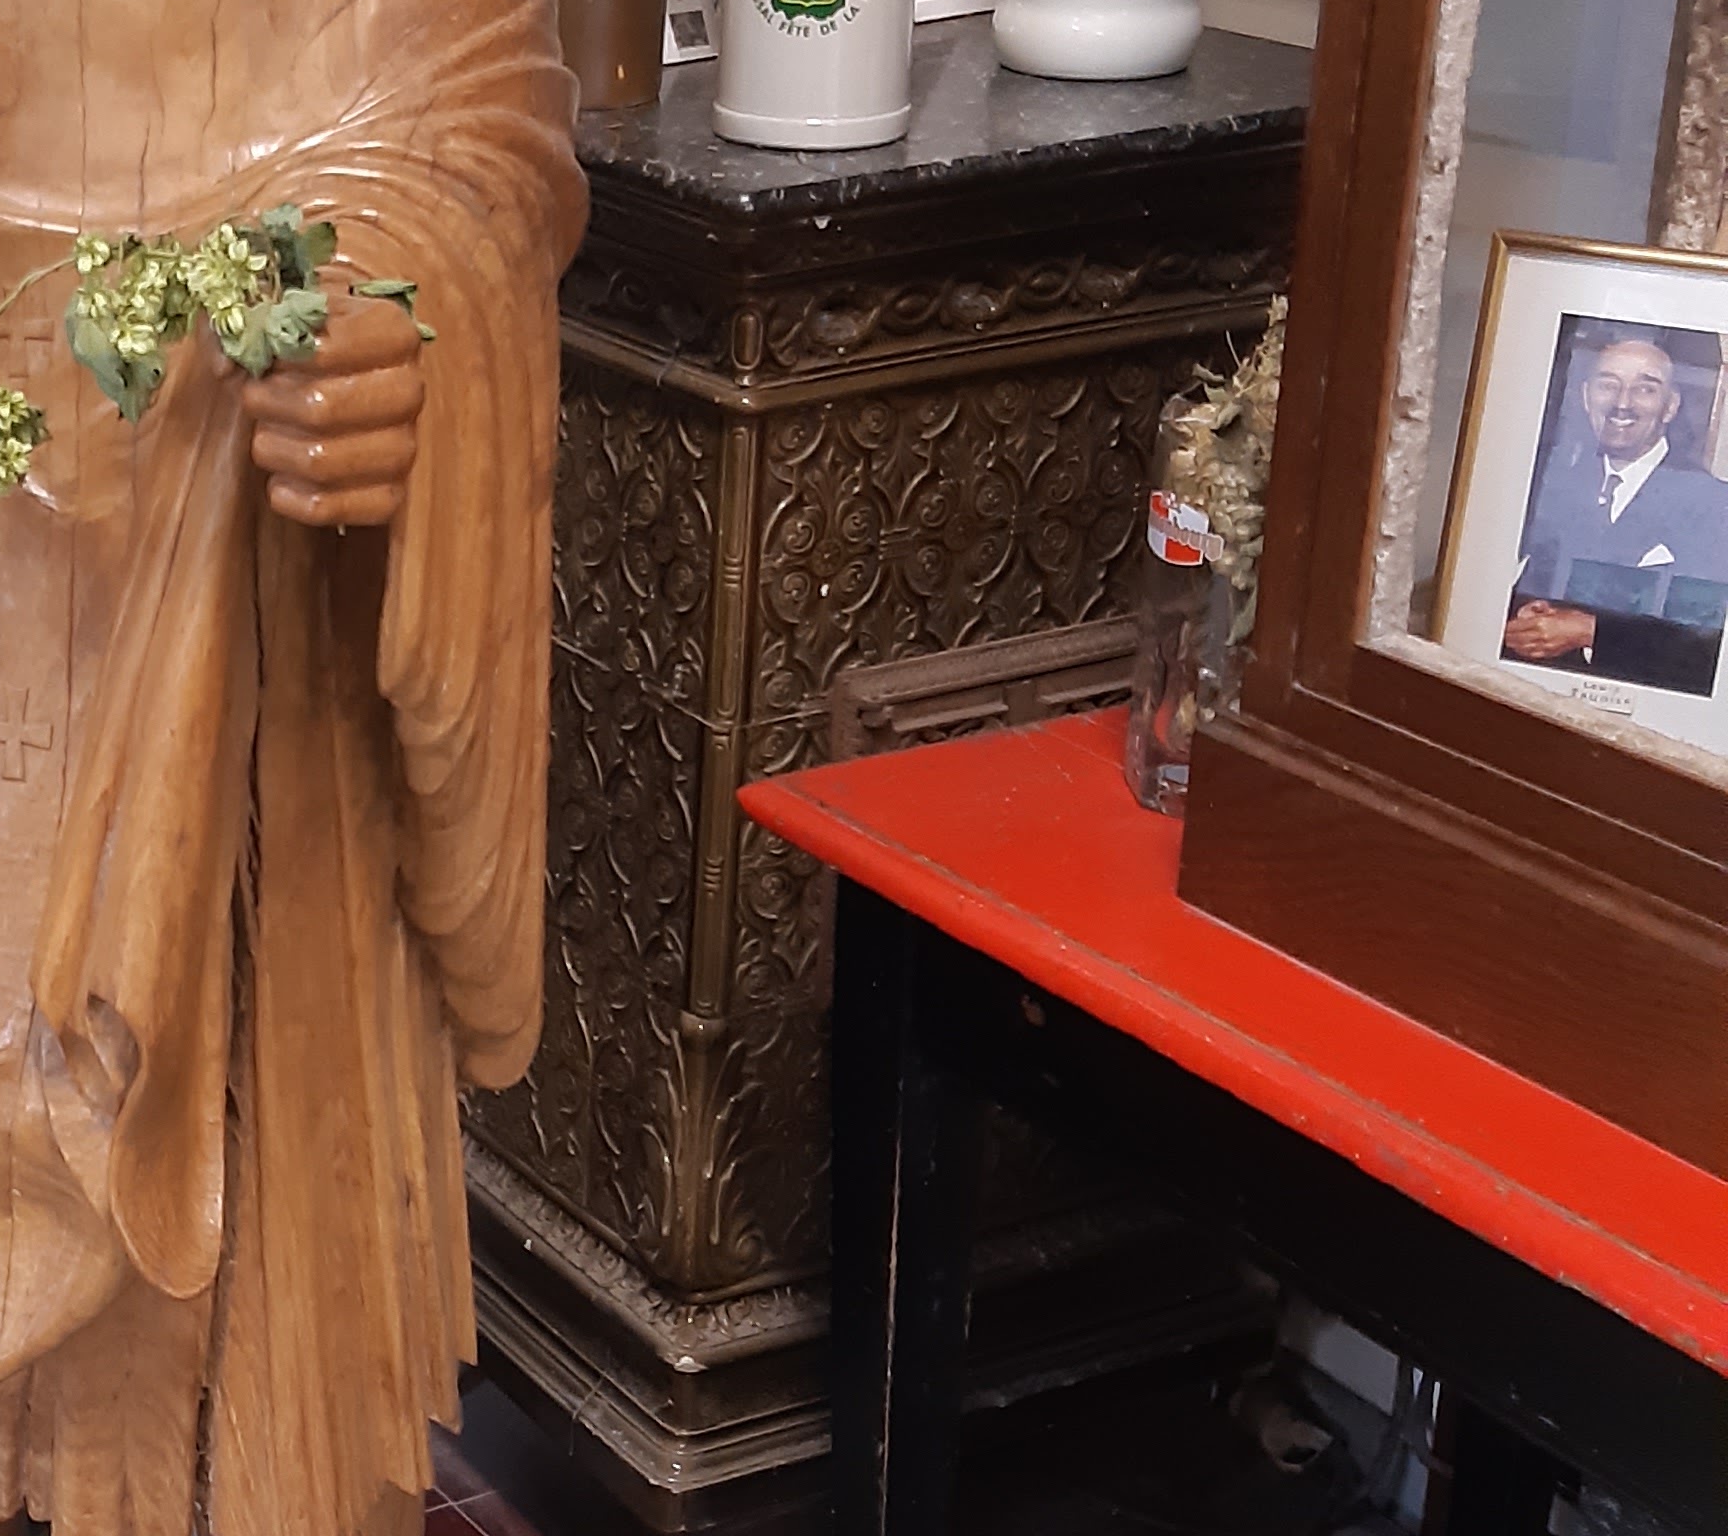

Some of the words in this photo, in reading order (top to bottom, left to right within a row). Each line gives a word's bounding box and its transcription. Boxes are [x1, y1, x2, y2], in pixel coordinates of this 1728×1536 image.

[778, 19, 812, 39] FÊTE
[819, 19, 839, 37] DE
[842, 4, 862, 24] LA
